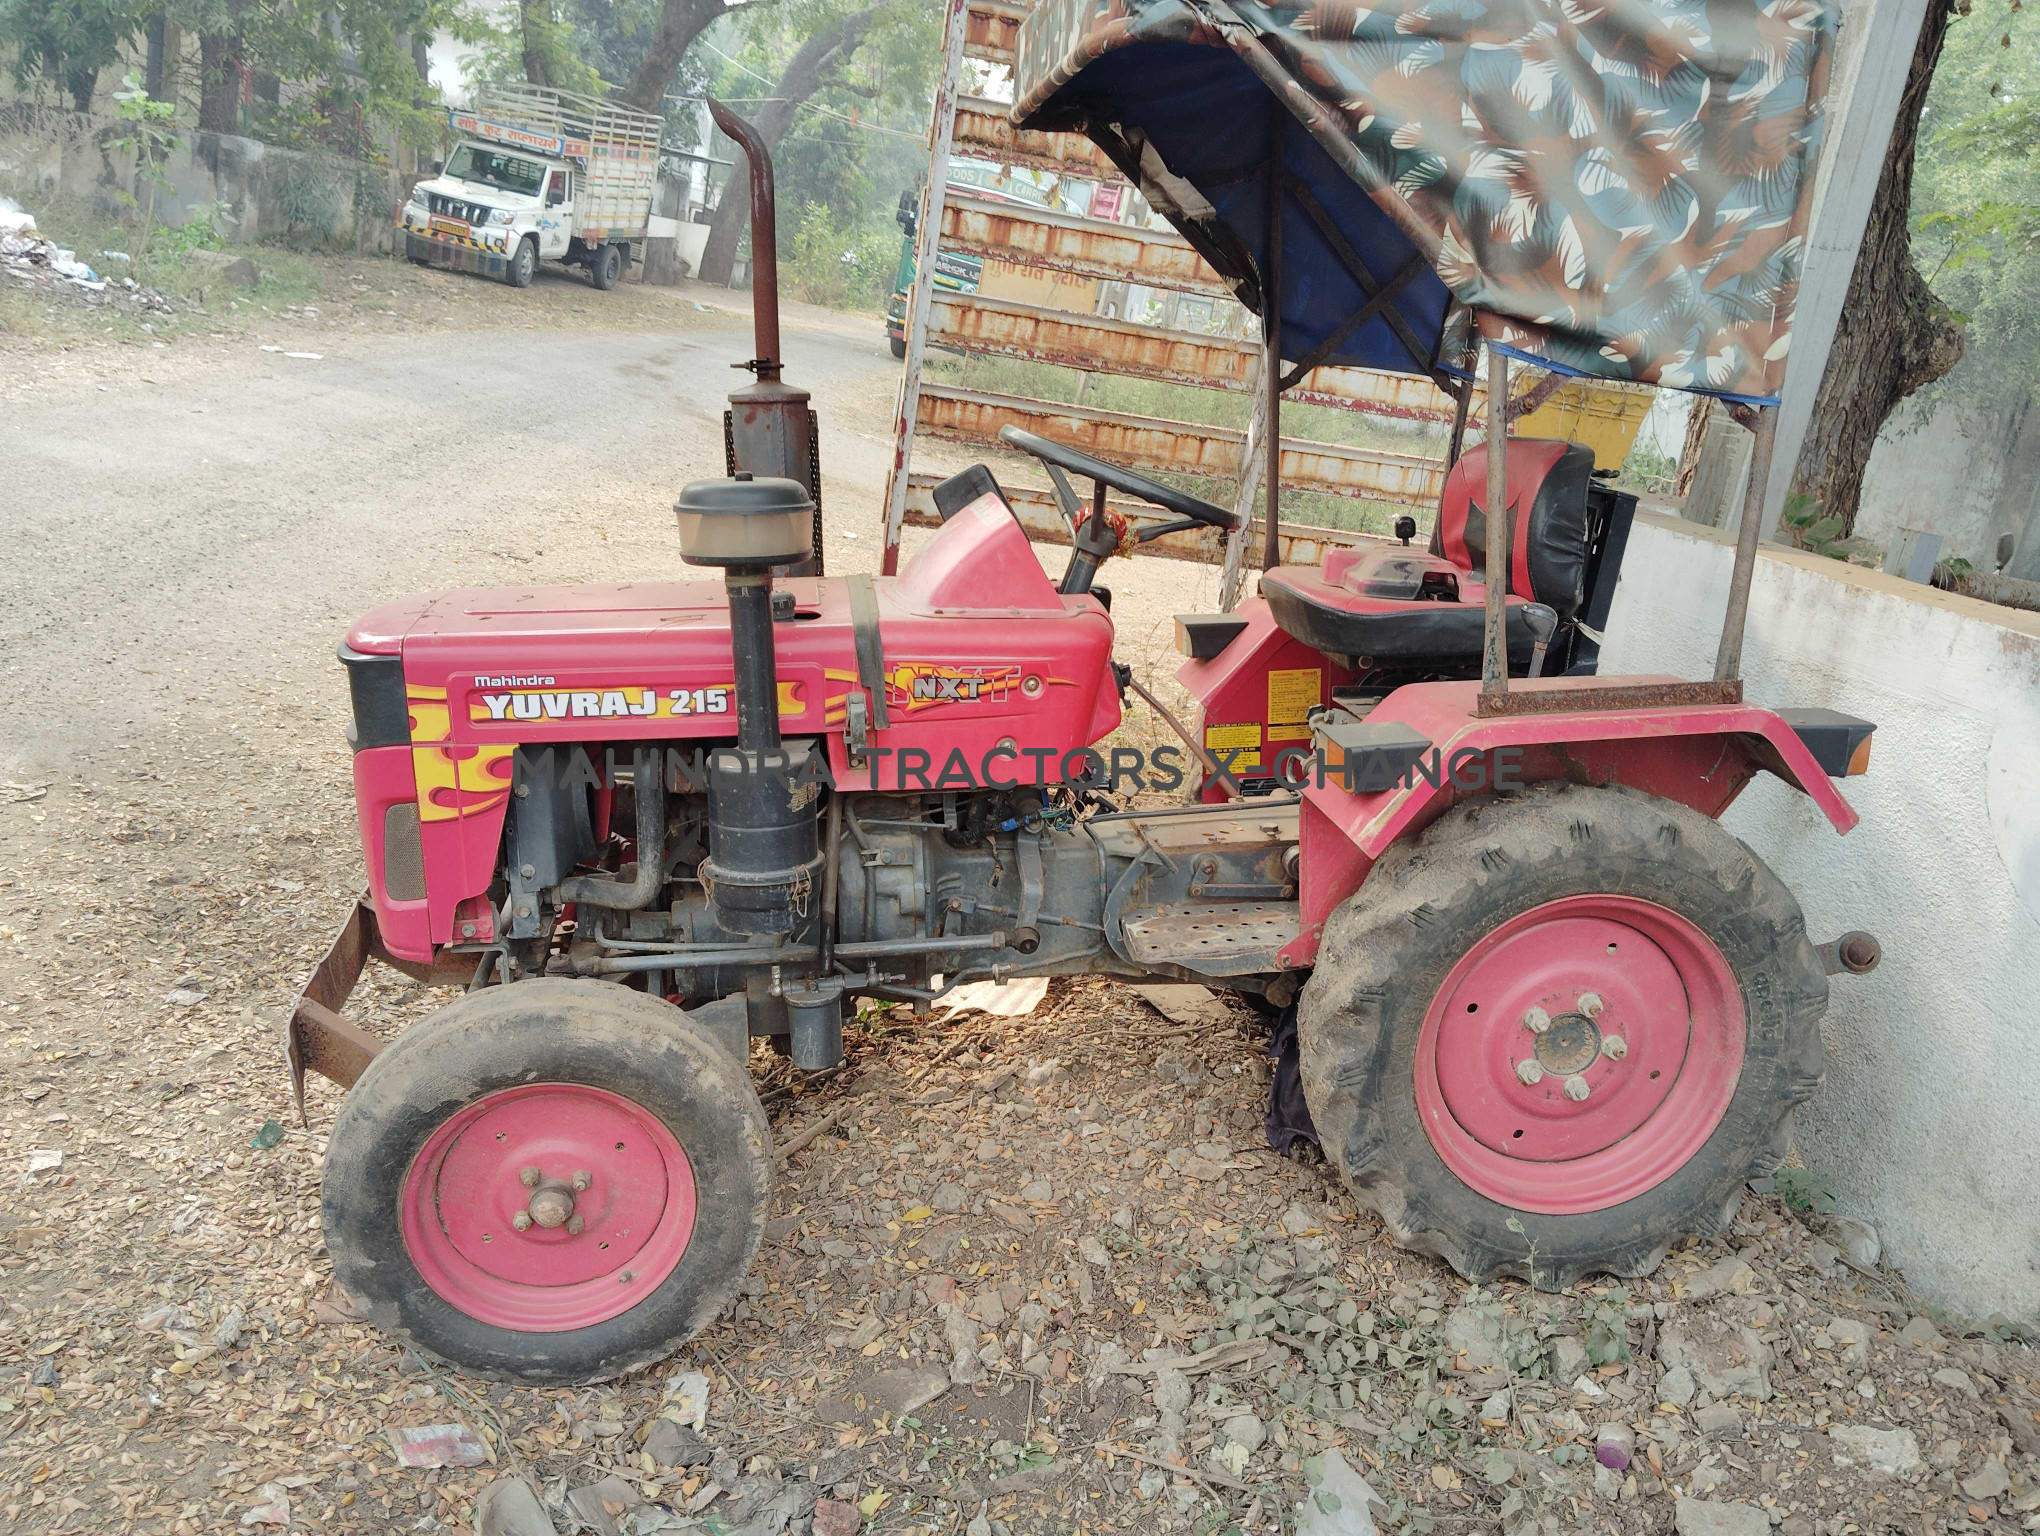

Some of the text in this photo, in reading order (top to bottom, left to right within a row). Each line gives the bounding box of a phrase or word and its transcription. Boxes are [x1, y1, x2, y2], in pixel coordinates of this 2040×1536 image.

[474, 675, 555, 687] Mahindra
[914, 678, 985, 698] NXT
[482, 688, 728, 719] YUVRAJ 215
